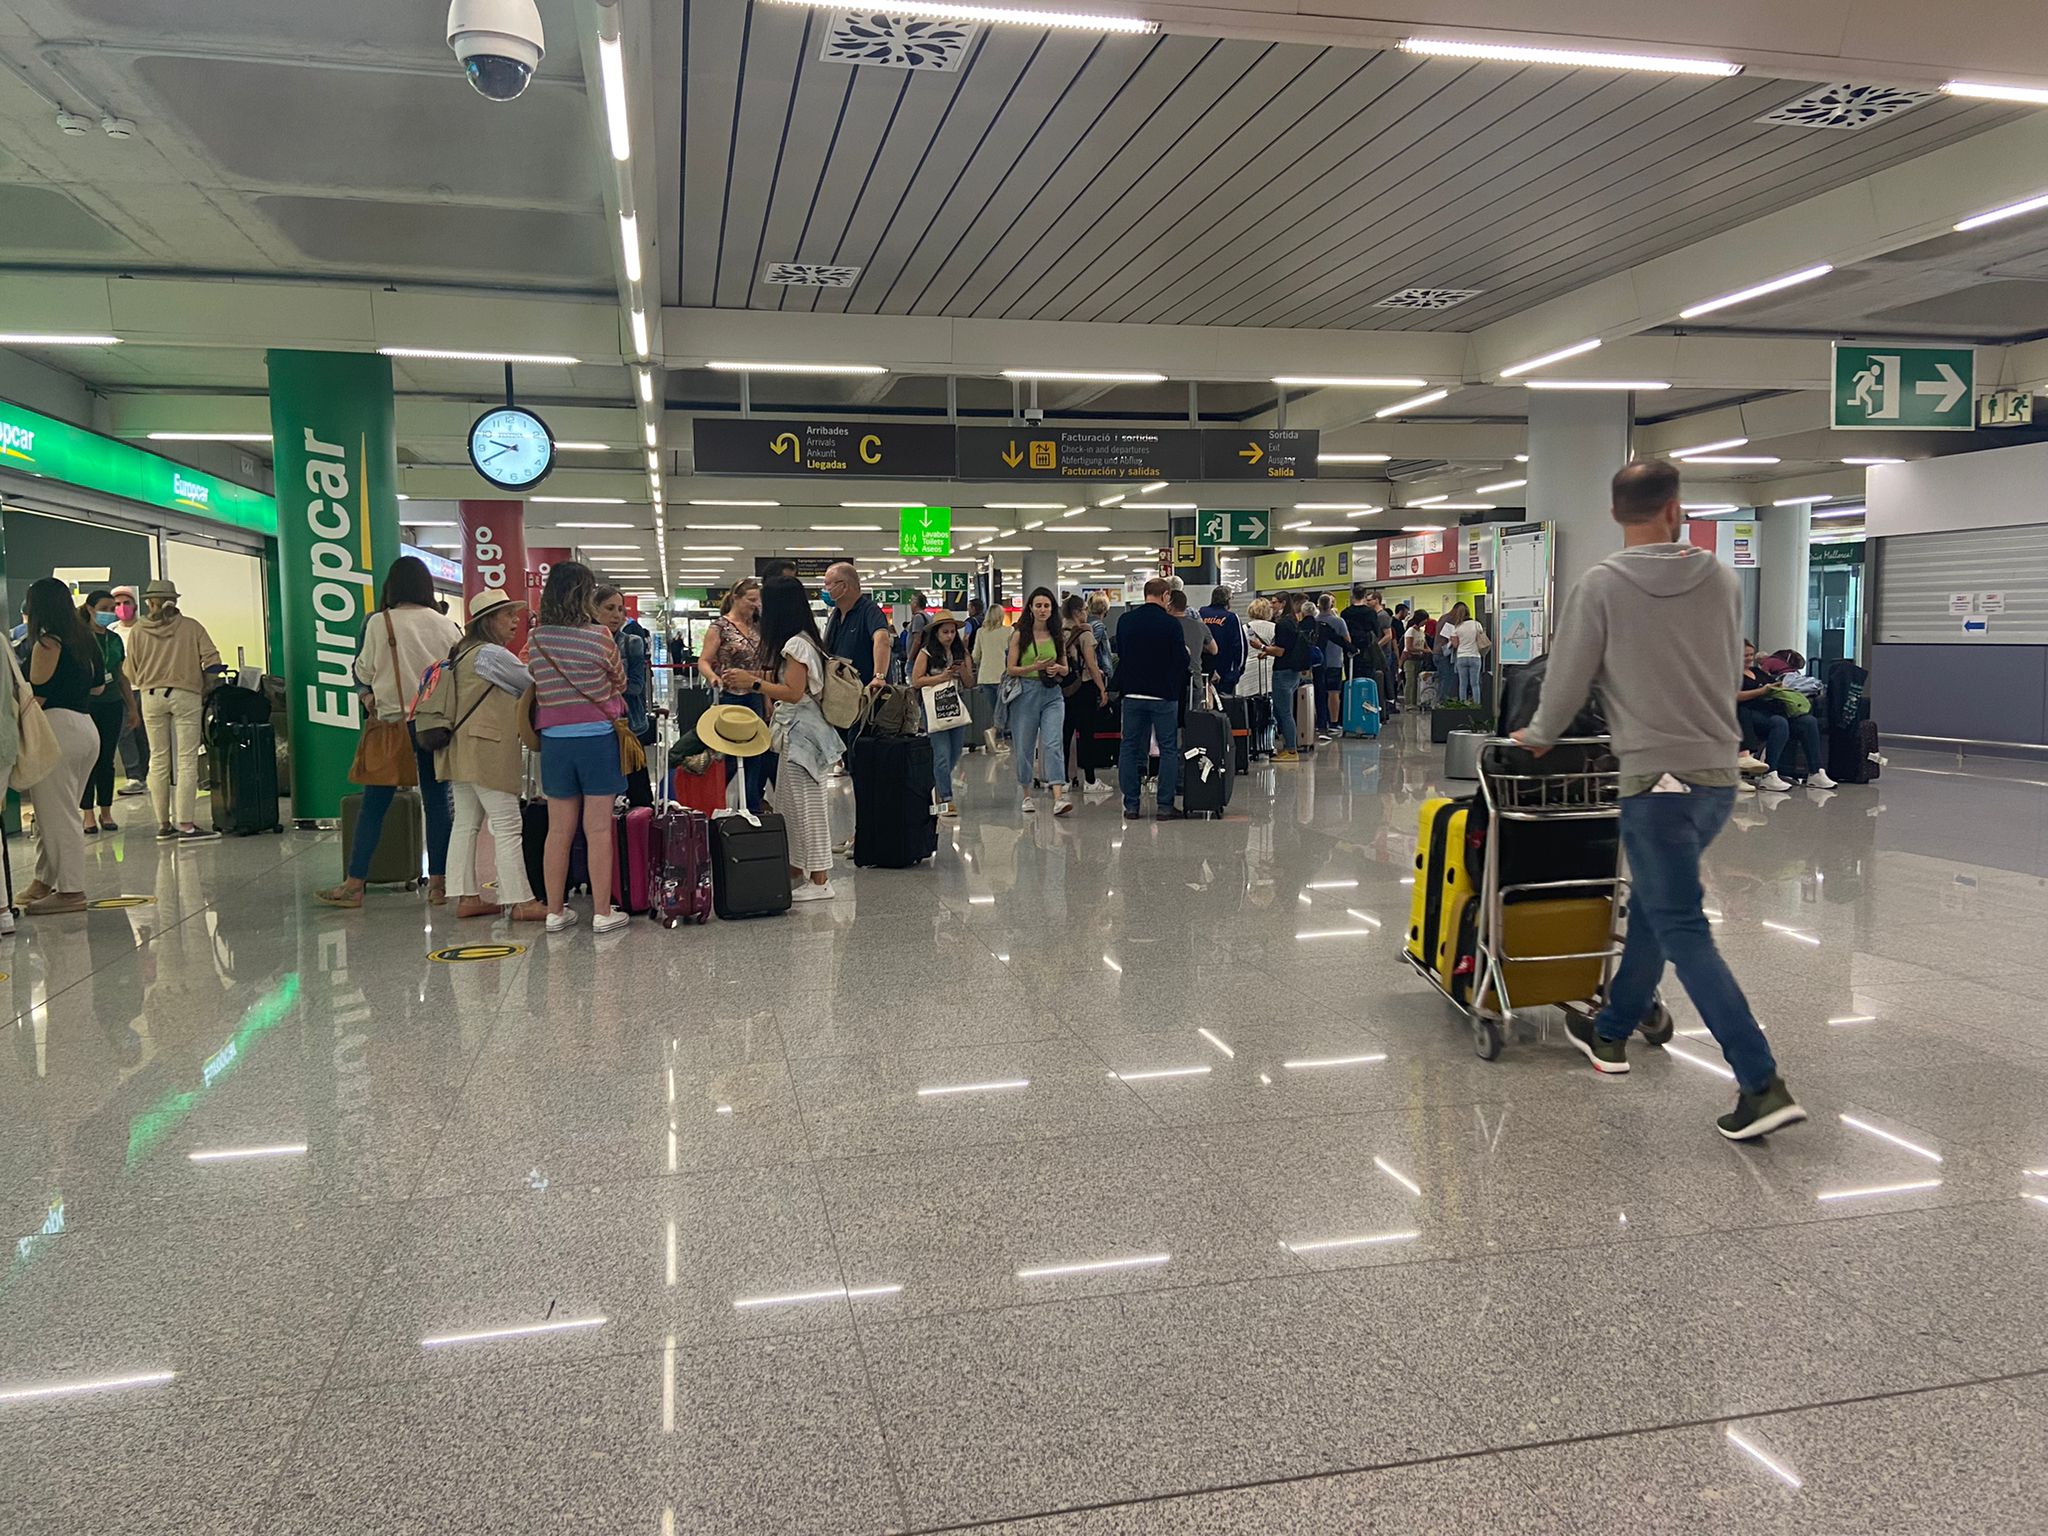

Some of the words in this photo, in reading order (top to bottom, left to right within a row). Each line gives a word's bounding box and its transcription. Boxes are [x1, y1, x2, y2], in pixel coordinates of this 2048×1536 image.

[505, 416, 515, 424] 12
[806, 426, 849, 436] Arribades
[1268, 430, 1299, 440] Sortida
[1061, 432, 1111, 442] Facturació
[806, 438, 836, 447] Arrivals
[1268, 443, 1280, 452] Exit
[478, 444, 486, 452] 9
[538, 445, 545, 453] 3
[806, 448, 836, 458] Ankunft
[859, 434, 882, 464] C
[1061, 445, 1094, 454] Check-in
[1095, 445, 1109, 454] and
[1111, 445, 1150, 455] departures
[807, 460, 847, 471] Llegadas
[1061, 456, 1103, 466] Abfertigung
[1268, 456, 1296, 466] Ausgang
[496, 468, 503, 477] 7
[510, 473, 518, 481] 6
[1061, 466, 1117, 476] Facturación
[1119, 468, 1126, 478] y
[1128, 467, 1160, 476] salidas
[1268, 467, 1294, 477] Salida
[174, 473, 208, 505] Europcar
[921, 530, 949, 539] Lavabos
[922, 538, 944, 546] Toilets
[921, 545, 943, 553] Aseos
[1275, 556, 1325, 580] GOLDCAR
[304, 427, 373, 730] Europcar
